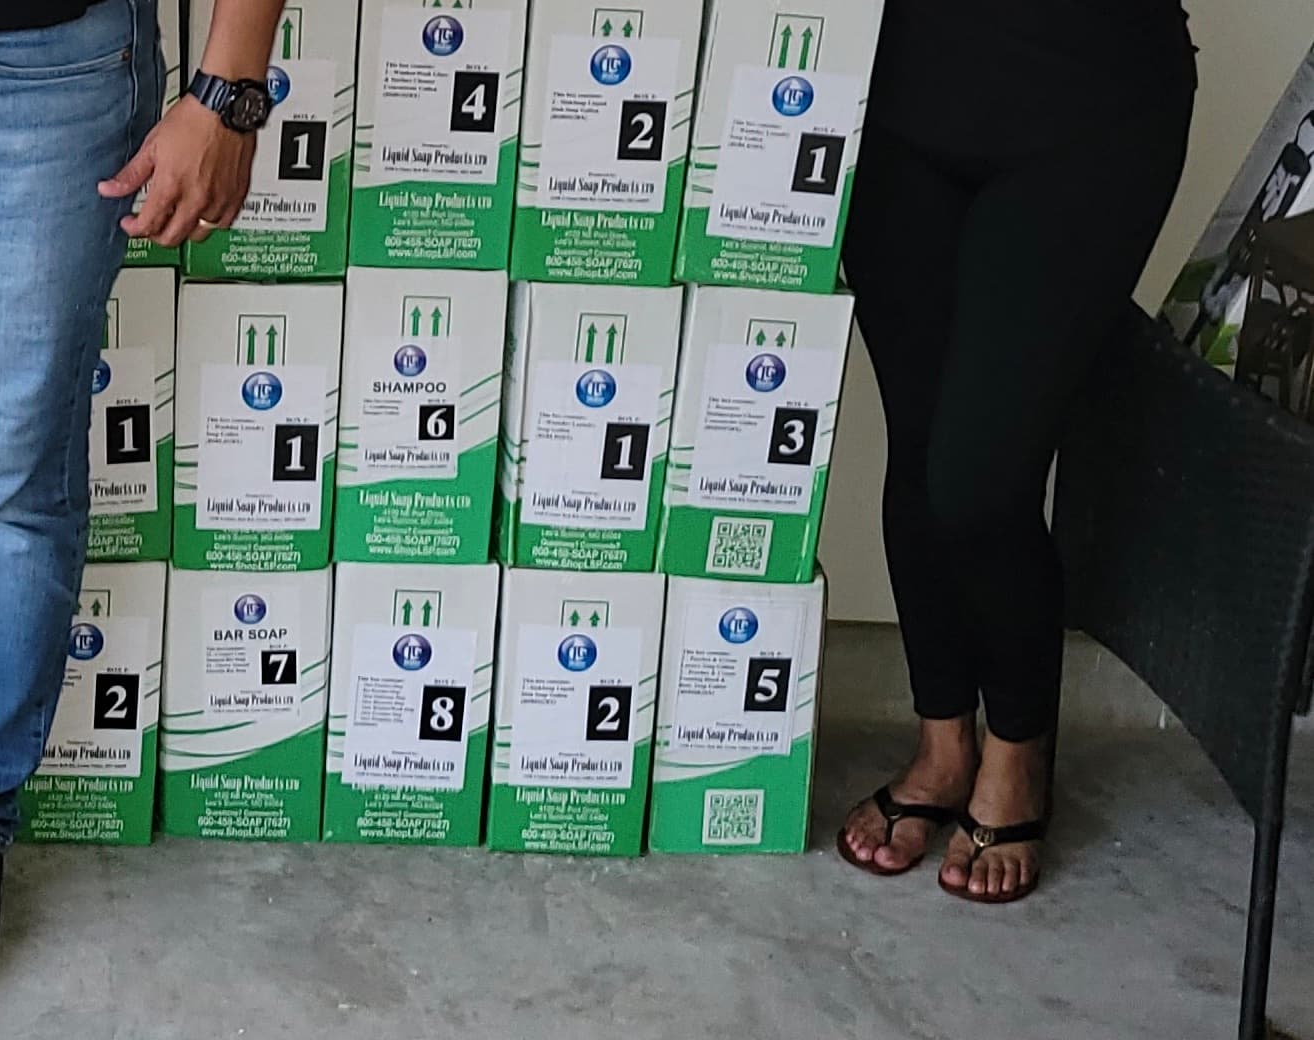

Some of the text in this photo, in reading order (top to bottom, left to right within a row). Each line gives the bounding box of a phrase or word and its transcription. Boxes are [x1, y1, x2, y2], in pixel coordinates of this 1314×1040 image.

[461, 83, 487, 121] 4
[628, 113, 654, 149] 2
[291, 132, 312, 170] 1
[383, 147, 409, 164] Liquid
[412, 149, 432, 166] Soap
[434, 150, 472, 165] Products
[804, 146, 827, 184] 1
[549, 176, 576, 194] Liquid
[579, 177, 598, 194] Soap
[601, 179, 637, 193] Products
[262, 200, 298, 213] Products
[379, 191, 406, 209] Liquid
[410, 191, 432, 210] Soap
[435, 192, 474, 209] Products
[542, 211, 569, 229] Liquid
[573, 212, 594, 230] Soap
[597, 213, 637, 229] Products
[720, 203, 747, 222] Liquid
[750, 205, 769, 225] Soap
[772, 209, 806, 227] Products
[373, 382, 447, 394] SHAMPOO
[426, 408, 448, 439] 6
[118, 417, 140, 453] 1
[778, 419, 805, 454] 3
[285, 435, 306, 471] 1
[613, 433, 634, 470] 1
[95, 482, 133, 497] Products
[699, 477, 726, 493] Liquid
[728, 478, 748, 496] Soap
[750, 480, 787, 495] Products
[207, 497, 234, 515] Liquid
[236, 499, 256, 516] Soap
[258, 498, 296, 513] Products
[359, 490, 389, 508] Liquid
[391, 490, 413, 510] Soap
[414, 491, 454, 508] Products
[532, 492, 559, 510] Liquid
[562, 494, 582, 513] Soap
[584, 495, 621, 512] Products
[214, 628, 288, 641] BAR SOAP
[268, 653, 289, 682] 7
[754, 668, 781, 703] 5
[104, 685, 128, 719] 2
[429, 696, 455, 731] 8
[595, 697, 620, 731] 2
[678, 726, 704, 741] Liquid
[706, 727, 726, 743] Soap
[727, 727, 761, 742] Products
[58, 747, 77, 762] Soap
[80, 747, 116, 760] Products
[354, 753, 380, 769] Liquid
[382, 755, 401, 771] Soap
[404, 755, 440, 771] Products
[521, 756, 546, 772] Liquid
[549, 757, 569, 773] Soap
[571, 757, 608, 772] Products
[25, 777, 52, 793] Liquid
[55, 777, 75, 793] Soap
[78, 777, 117, 792] Products
[190, 774, 218, 792] Liquid
[220, 774, 241, 792] Soap
[244, 774, 284, 791] Products
[516, 787, 545, 805] Liquid
[546, 787, 568, 806] Soap
[570, 788, 610, 805] Products
